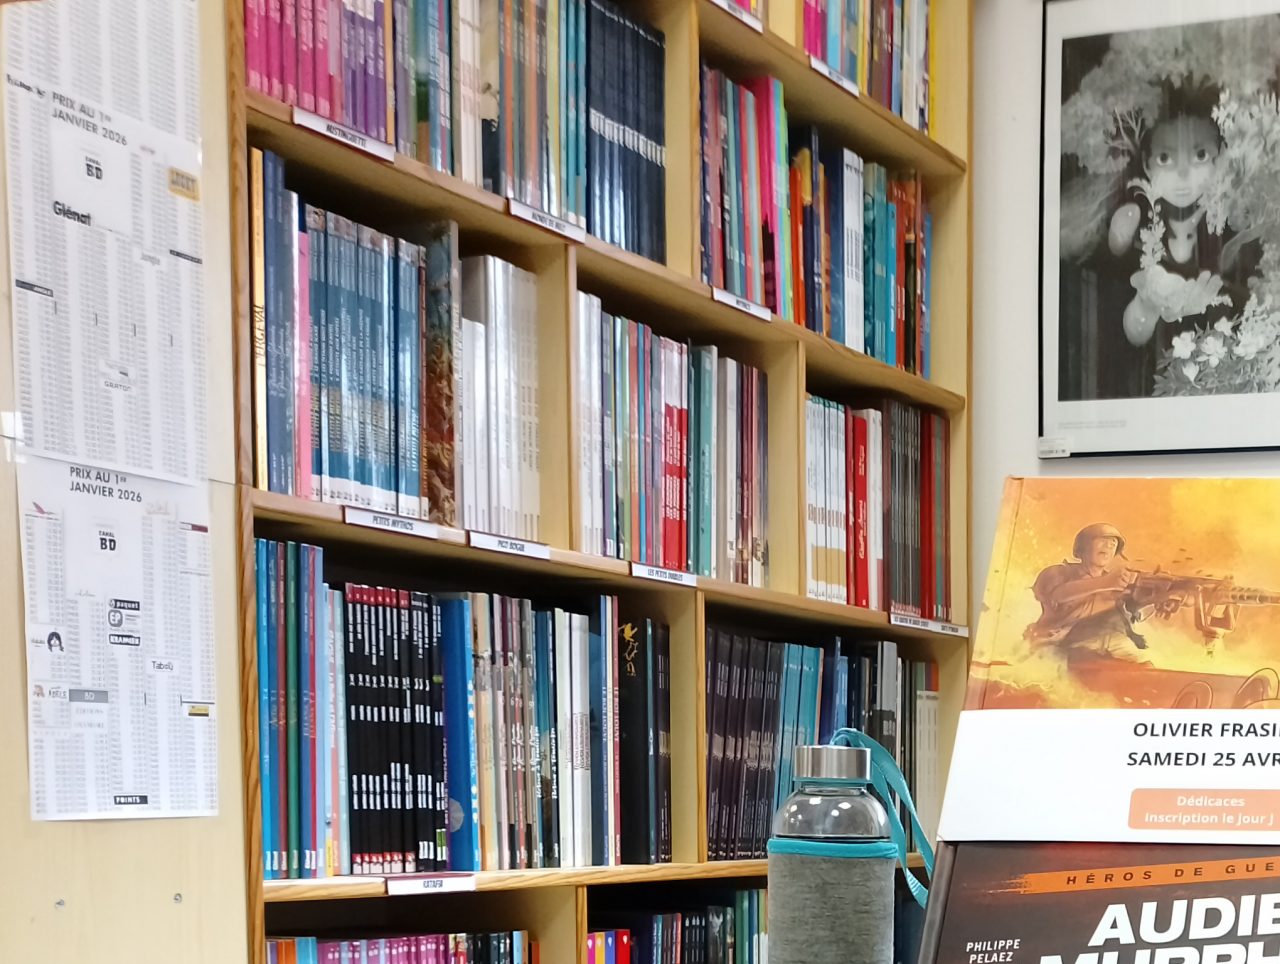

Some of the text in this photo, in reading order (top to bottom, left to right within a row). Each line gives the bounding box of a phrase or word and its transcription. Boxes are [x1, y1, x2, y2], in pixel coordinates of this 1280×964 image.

[52, 91, 75, 111] PRIX
[80, 103, 95, 119] AU
[52, 107, 127, 146] JANVIER 2026
[53, 200, 92, 227] Glénat
[69, 466, 92, 481] PRIX
[95, 472, 111, 483] AU
[69, 481, 142, 502] JANVIER 2026
[373, 515, 414, 531] PETITS MYTHOS
[99, 537, 116, 551] BD
[655, 570, 667, 579] PETITS
[1133, 722, 1213, 737] OLIVIER
[1127, 752, 1206, 766] SAMEDI
[1212, 752, 1236, 767] 25
[1177, 795, 1246, 808] Dédicaces
[1145, 812, 1218, 826] Inscription
[1223, 812, 1234, 824] le
[1066, 869, 1153, 886] HÉROS
[1174, 866, 1204, 878] DE
[966, 938, 1022, 954] PHILIPPE
[969, 950, 1014, 964] PELAEZ
